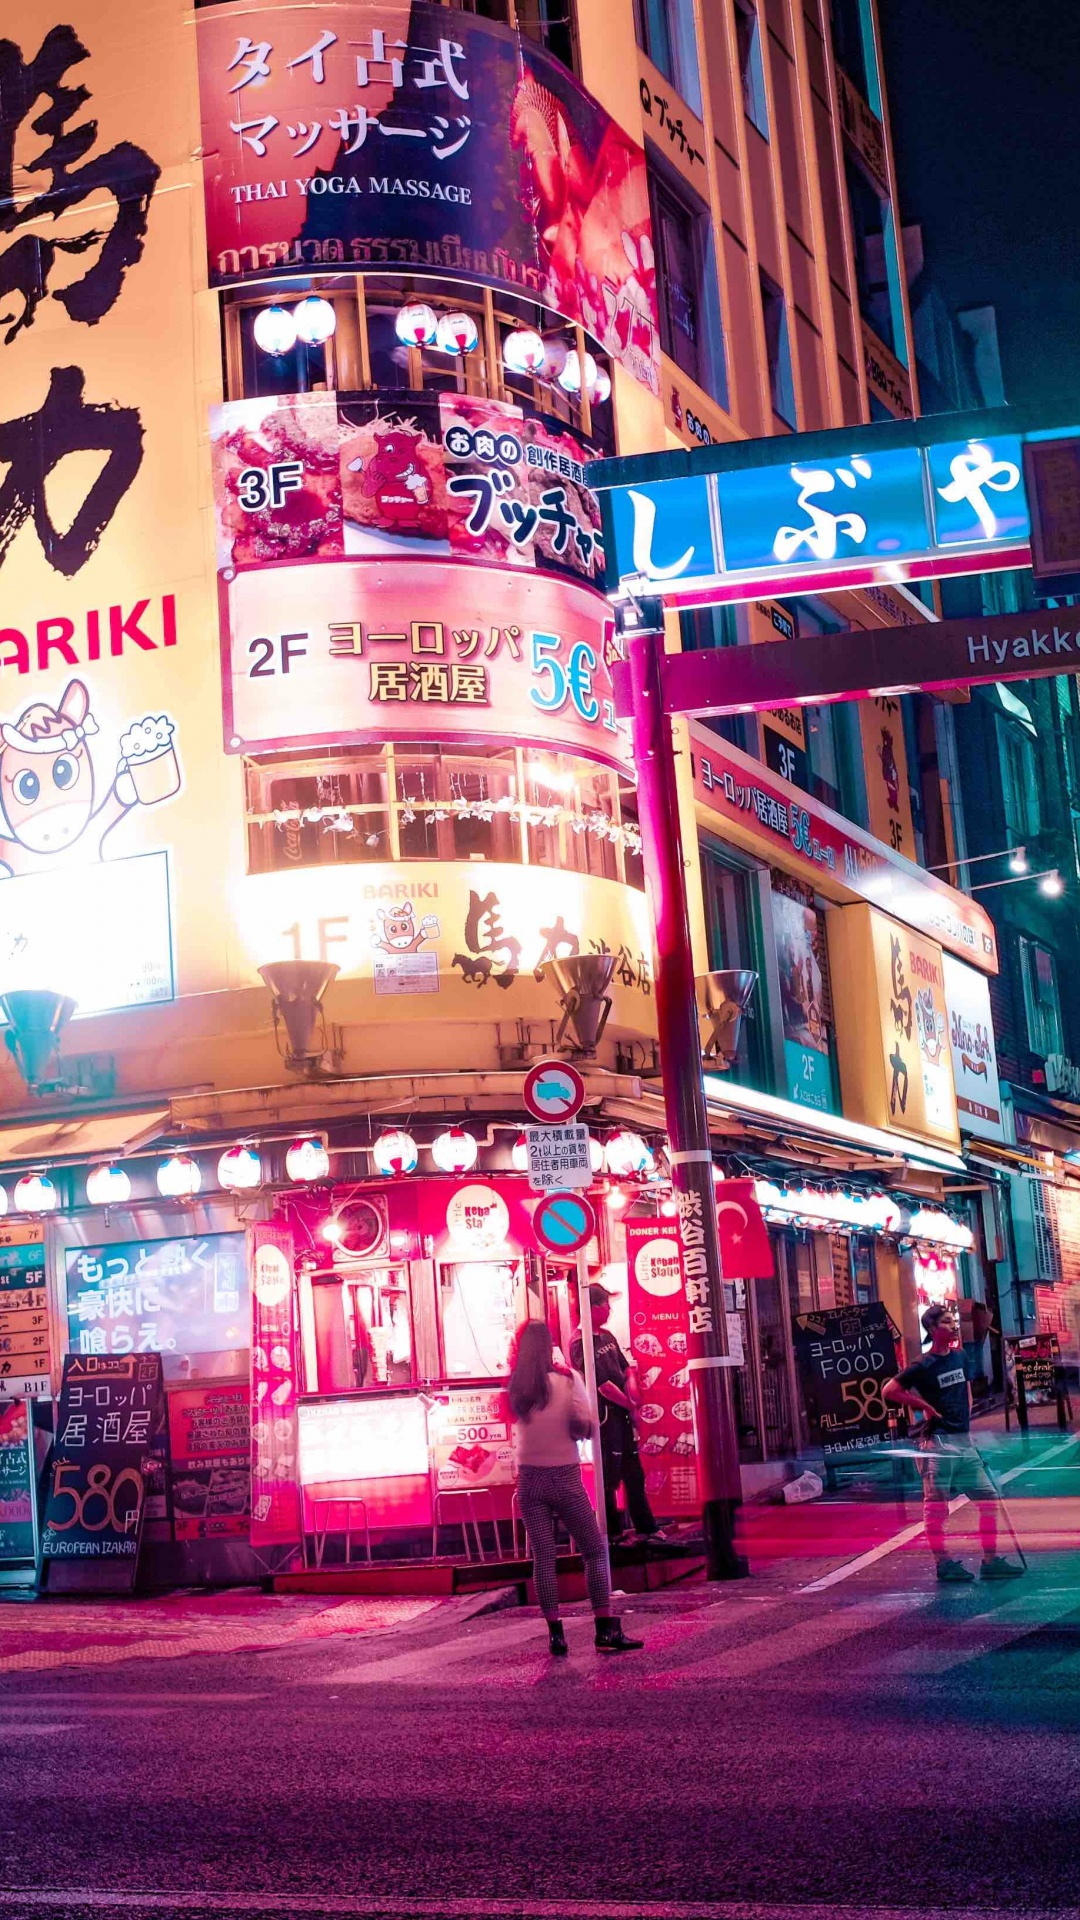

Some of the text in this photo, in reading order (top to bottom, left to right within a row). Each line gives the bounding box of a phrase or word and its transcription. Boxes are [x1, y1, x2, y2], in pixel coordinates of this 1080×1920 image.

[227, 29, 470, 100] タイ古式
[229, 105, 471, 160] マッサージ
[231, 176, 472, 206] THAI YOGA MASSAGE
[448, 429, 521, 462] お肉の
[238, 464, 303, 510] 3F
[628, 439, 1021, 581] しぶや
[328, 621, 523, 660] ヨーロッパ
[249, 633, 309, 678] 2F
[368, 661, 488, 704] 居酒屋
[528, 633, 600, 722] 5€
[778, 743, 796, 783] 3F
[889, 819, 902, 852] 3F
[363, 882, 439, 900] BARIKI
[282, 916, 349, 961] 1F
[802, 1054, 815, 1082] 2F
[529, 1128, 586, 1143] 最大積載量
[531, 1157, 589, 1171] 居住者用車両
[532, 1173, 563, 1186] を除く
[465, 1206, 490, 1217] Keba
[29, 1230, 39, 1240] 7F
[629, 1226, 659, 1237] DONER
[77, 1242, 213, 1283] もっと熱く
[650, 1256, 679, 1268] Kebab
[677, 1191, 713, 1334] 渋谷百軒店
[25, 1271, 42, 1284] 5F
[22, 1290, 46, 1308] 4F
[77, 1286, 162, 1322] 豪快に
[32, 1315, 43, 1326] 3F
[652, 1312, 679, 1321] MENU
[33, 1336, 44, 1346] 2F
[810, 1333, 875, 1357] ヨーロッパ
[34, 1358, 45, 1368] 1F
[820, 1352, 885, 1379] FOOD
[24, 1381, 47, 1393] B1F
[68, 1384, 153, 1407] ヨーロッパ
[60, 1410, 151, 1447] 居酒屋
[821, 1413, 843, 1428] ALL
[458, 1427, 488, 1441] 500
[52, 1456, 70, 1470] ALL
[43, 1541, 100, 1555] EUROPEAN
